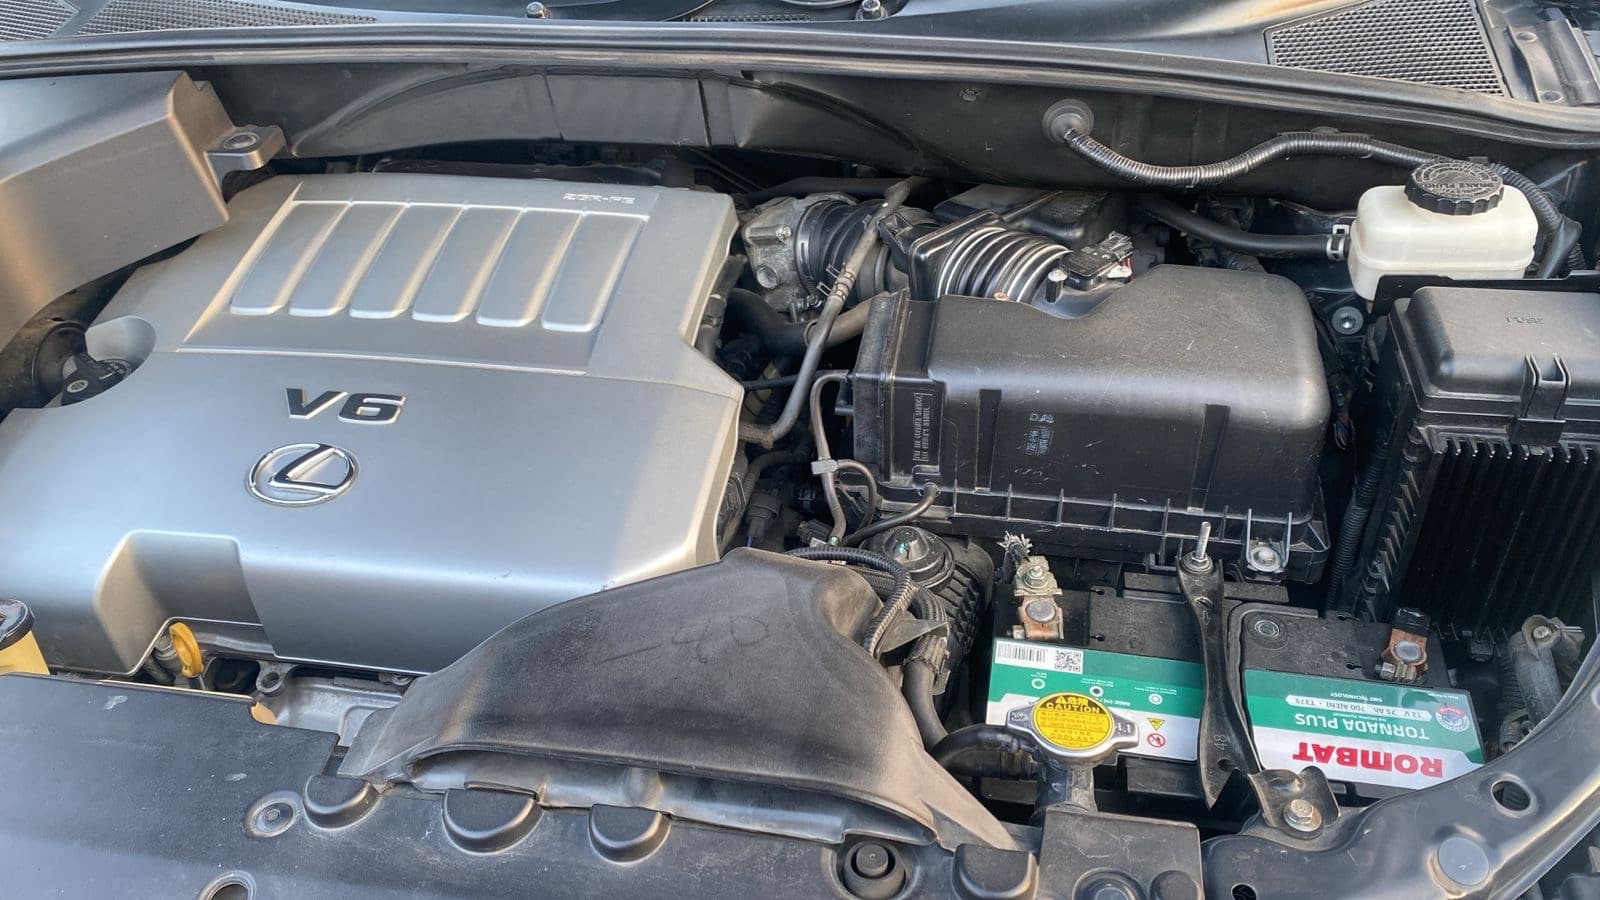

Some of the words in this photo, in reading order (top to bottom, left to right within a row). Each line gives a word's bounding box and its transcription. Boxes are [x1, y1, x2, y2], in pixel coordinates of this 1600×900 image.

[285, 387, 407, 425] V6
[1046, 702, 1100, 714] CAUTION
[1294, 713, 1340, 730] PLUS
[1343, 719, 1431, 740] TORNADA
[1053, 728, 1092, 736] ENGINE
[1292, 742, 1443, 778] ROMBAT
